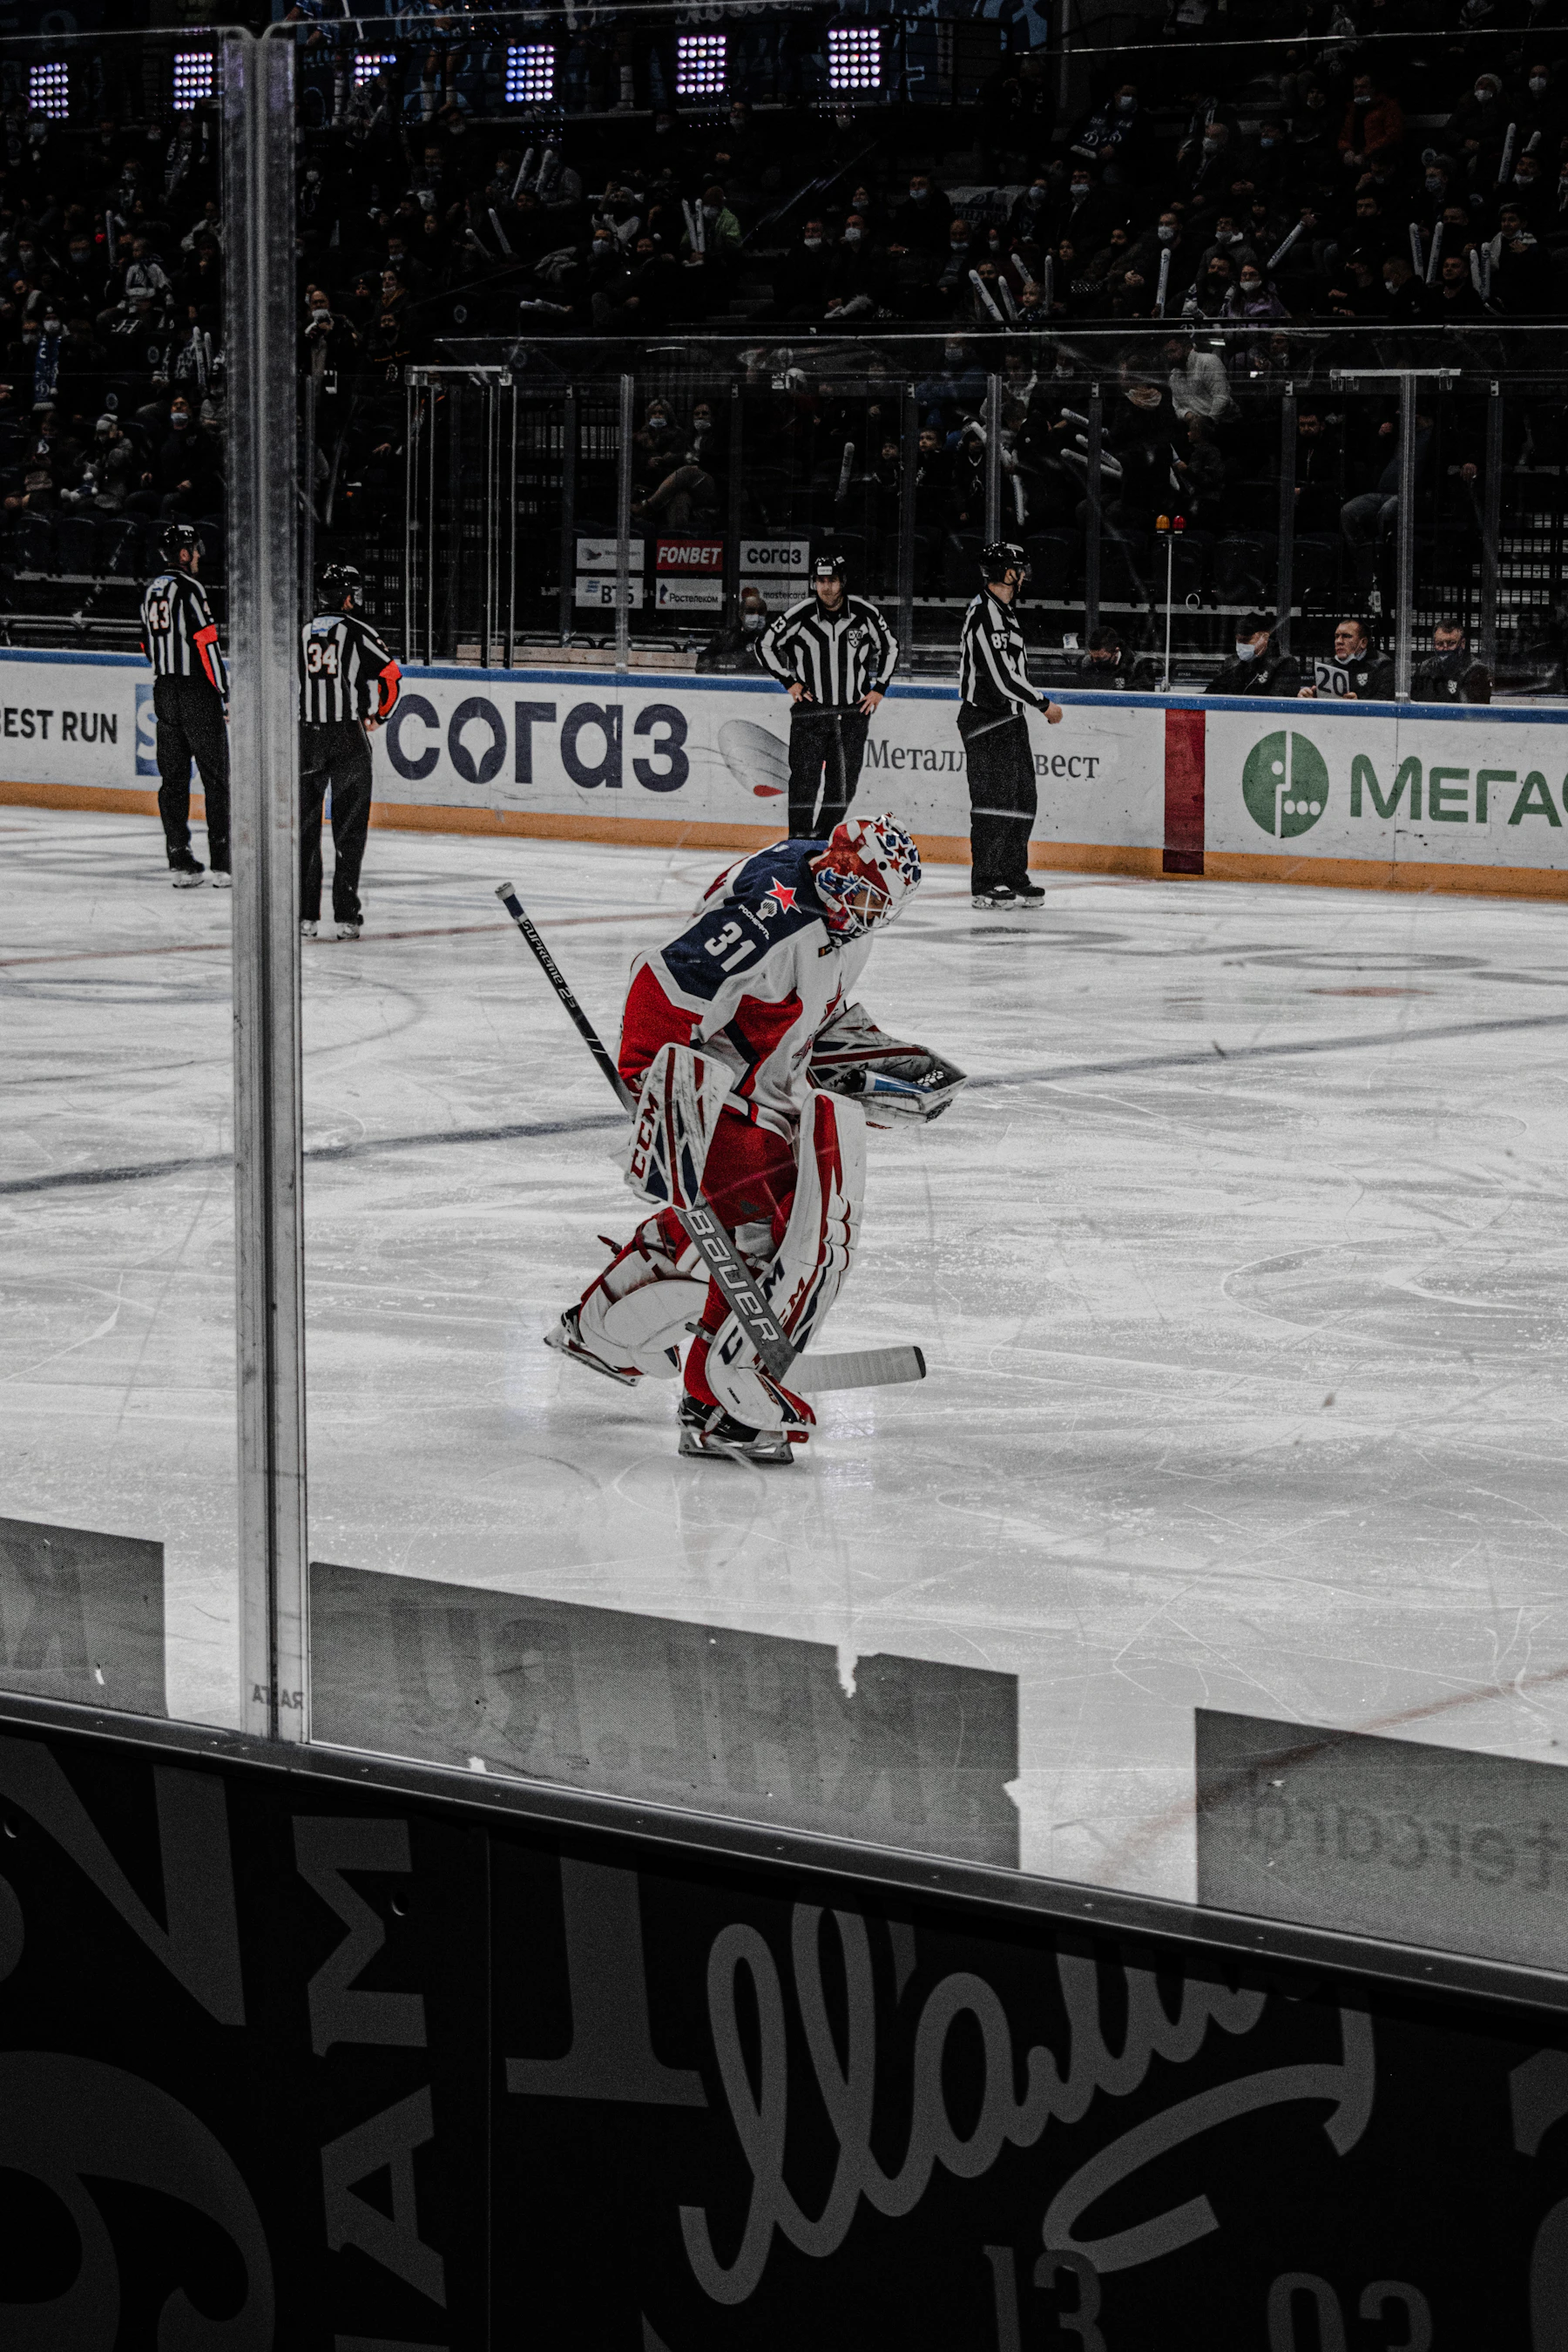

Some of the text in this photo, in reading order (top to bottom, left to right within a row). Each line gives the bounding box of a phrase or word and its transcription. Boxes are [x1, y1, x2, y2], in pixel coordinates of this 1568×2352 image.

[659, 546, 721, 564] FONBET
[669, 593, 719, 603] Ростелеком
[149, 600, 169, 630] 43
[991, 632, 1008, 650] 85
[308, 643, 338, 674] 34
[1315, 666, 1348, 695] 20
[0, 706, 54, 740] EST
[62, 711, 118, 744] RUN
[738, 903, 769, 940] РОСНЕФТЬ
[704, 921, 757, 973] 31
[630, 1091, 659, 1179] CCM
